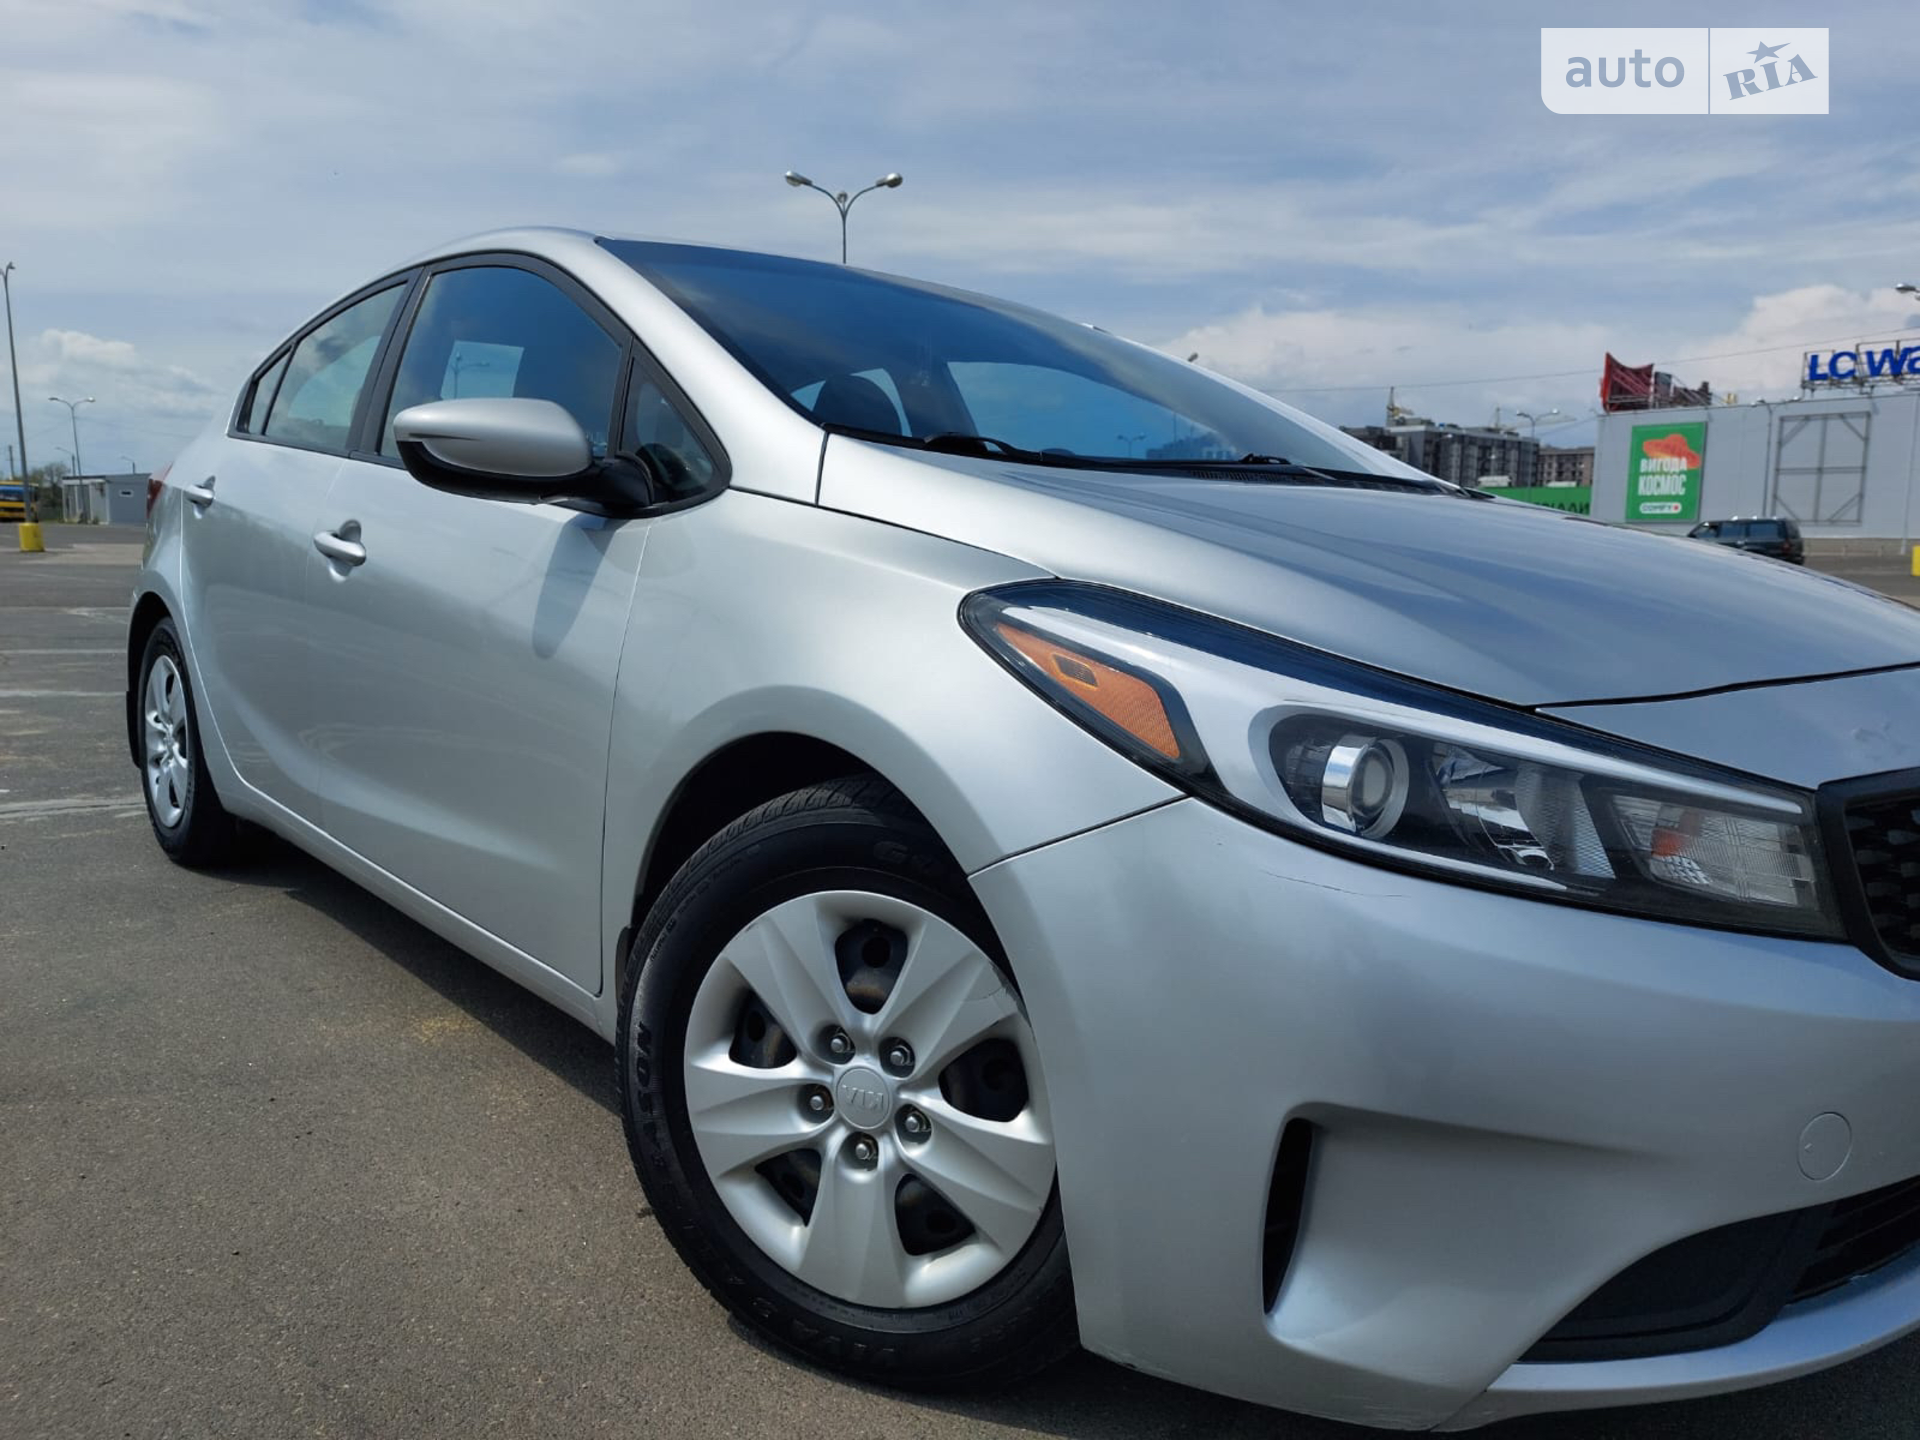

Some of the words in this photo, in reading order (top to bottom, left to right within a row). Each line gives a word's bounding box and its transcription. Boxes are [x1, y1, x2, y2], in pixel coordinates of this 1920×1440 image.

[1808, 351, 1858, 381] LC
[1640, 456, 1688, 474] ВИГОДА
[1637, 474, 1687, 496] КОСМОС
[841, 1084, 884, 1111] KIA
